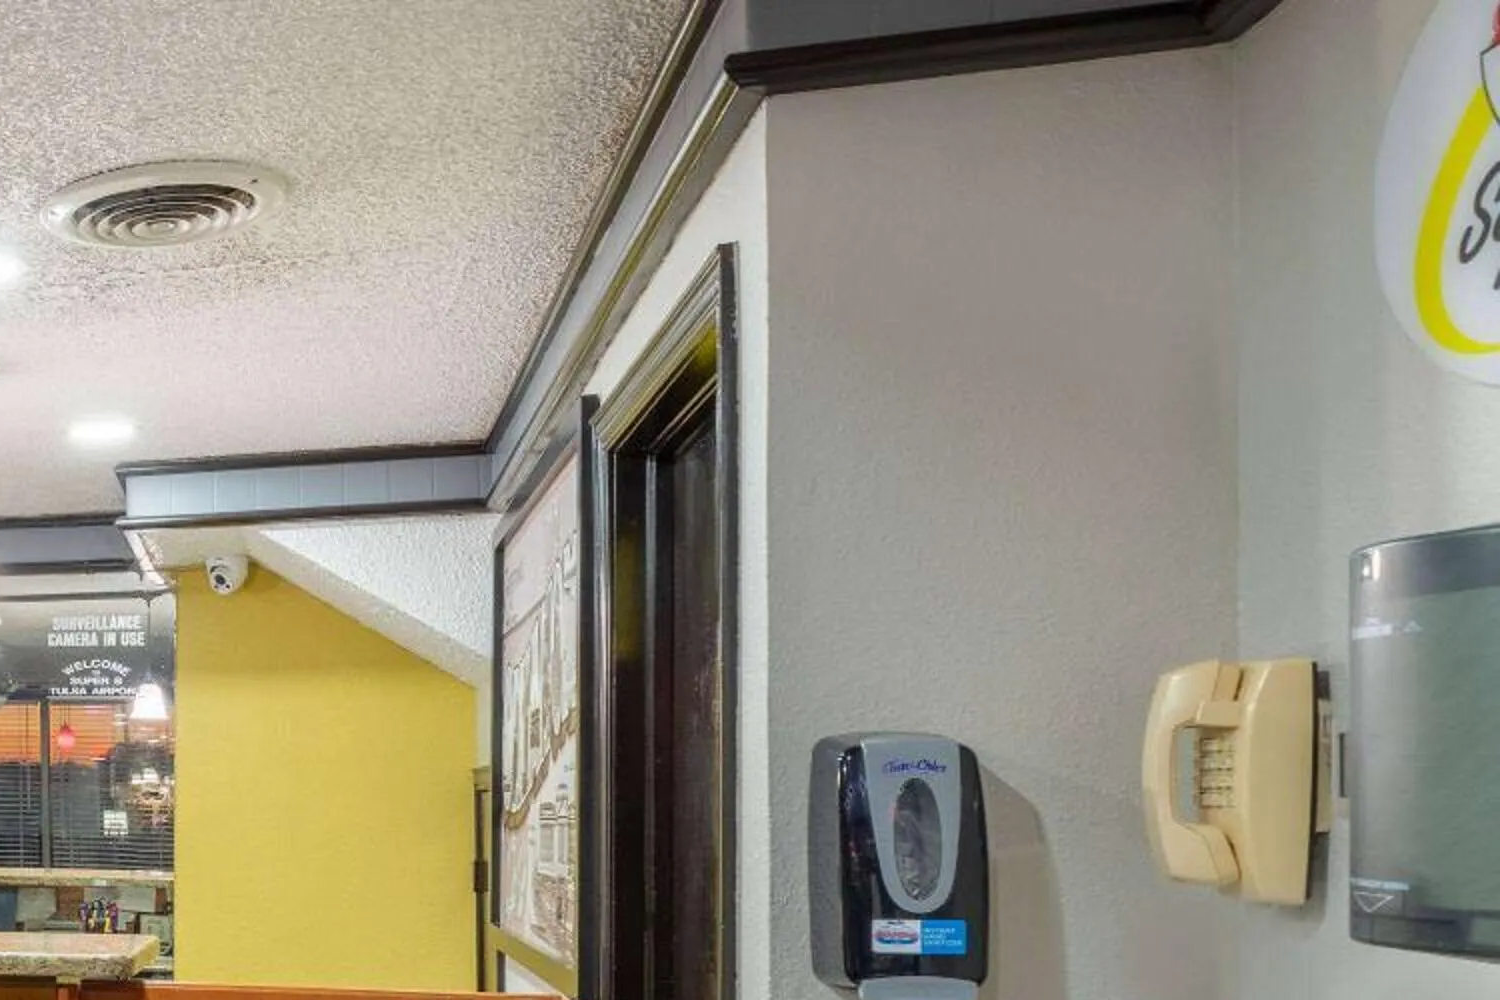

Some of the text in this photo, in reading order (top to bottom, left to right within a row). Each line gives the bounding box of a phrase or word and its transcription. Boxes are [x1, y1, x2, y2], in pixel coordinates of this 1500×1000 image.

[52, 615, 143, 631] SURVEILLANCE
[47, 631, 146, 647] CAMERA IN USE
[61, 659, 132, 677] WELCOME
[50, 687, 87, 696] TULSA
